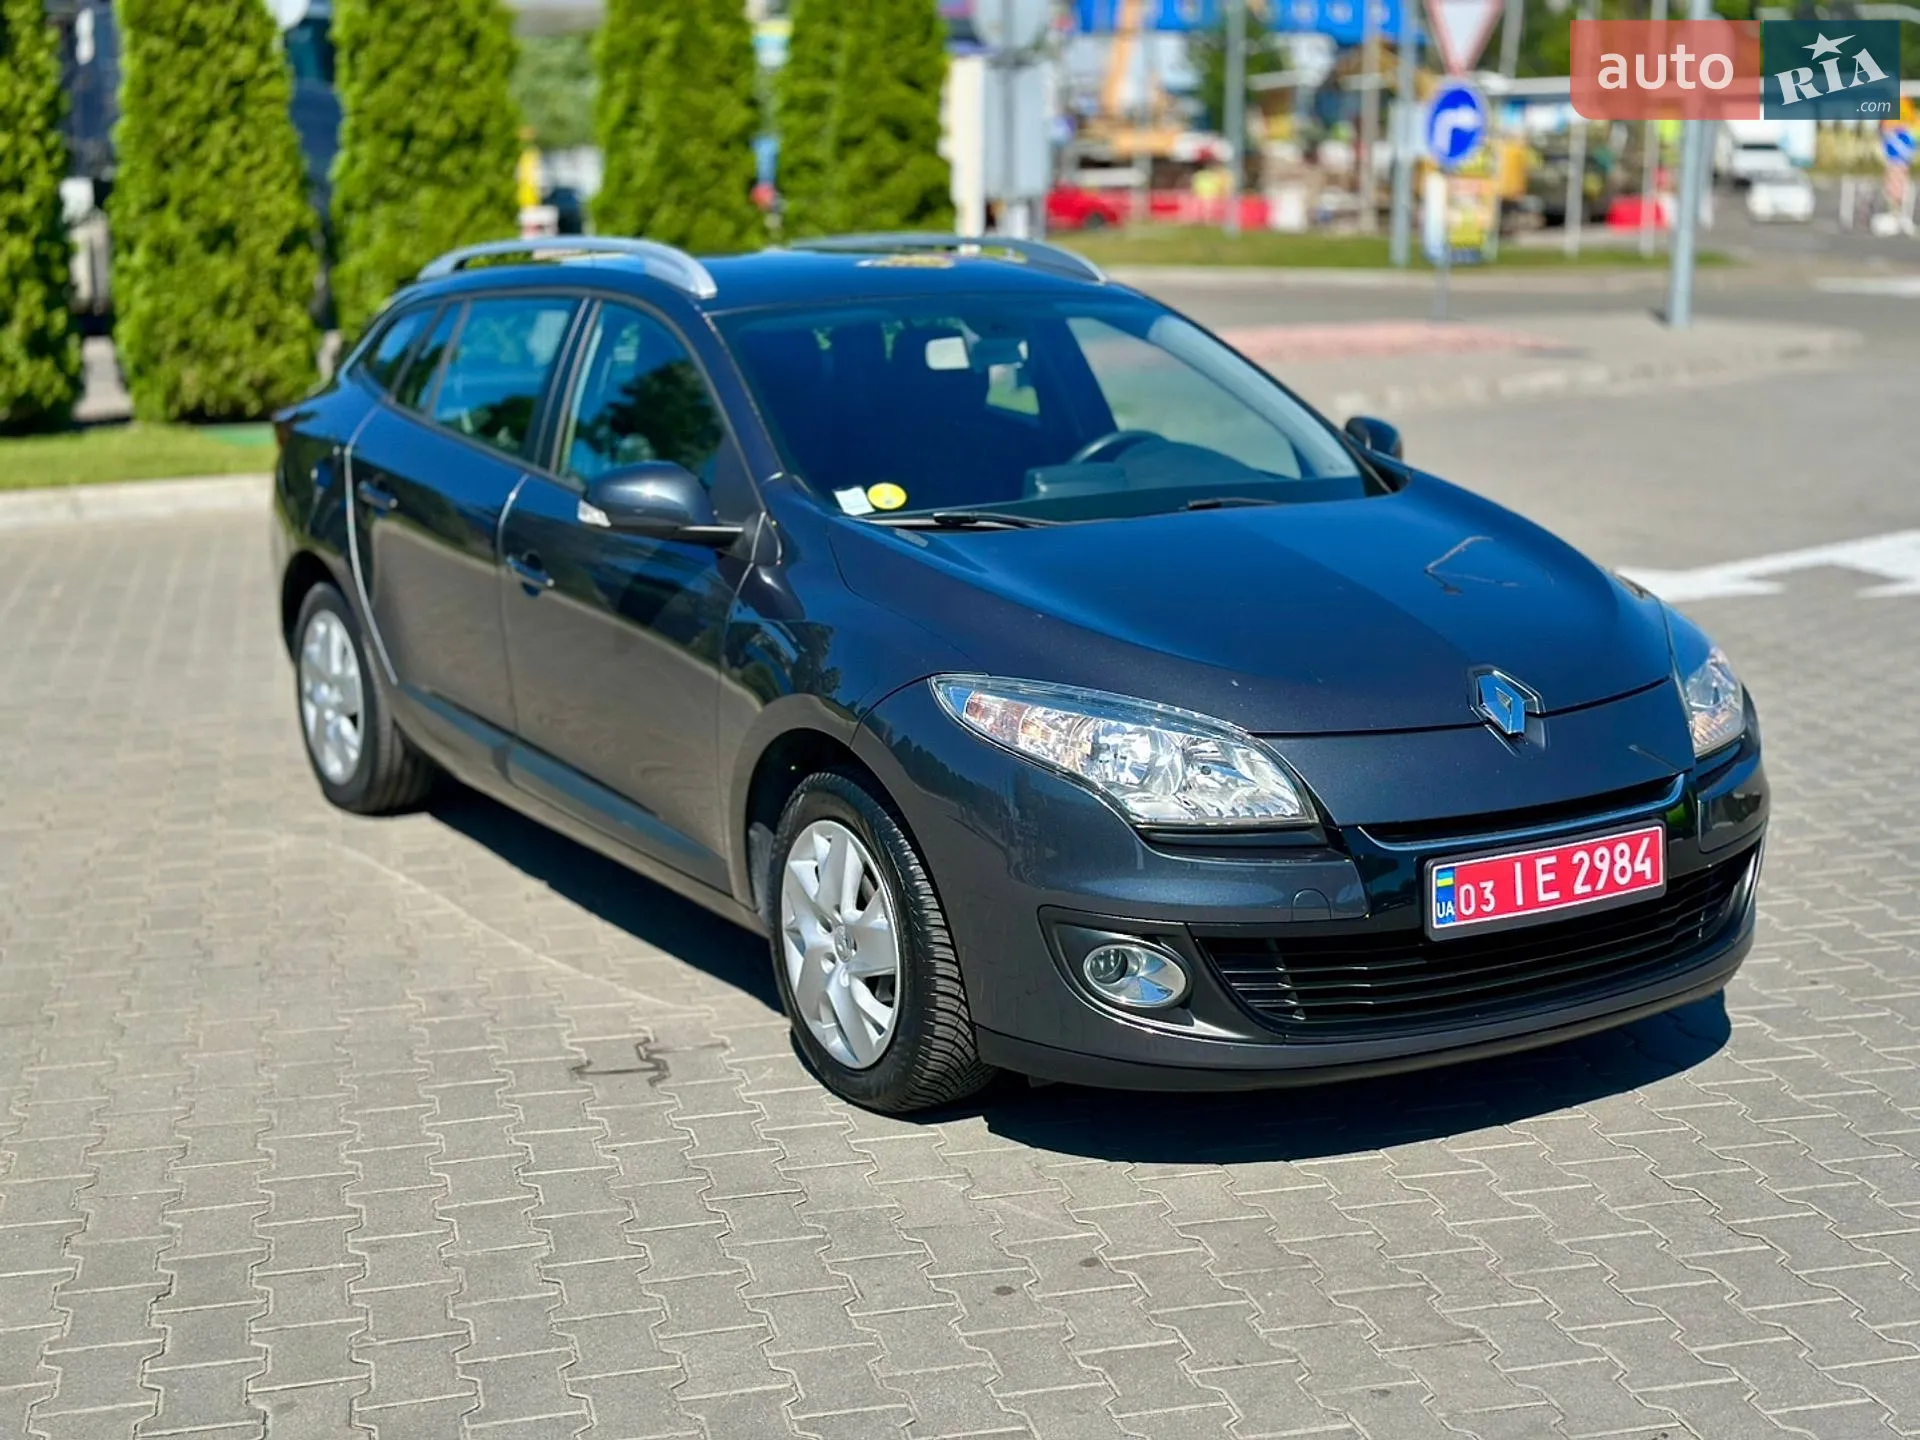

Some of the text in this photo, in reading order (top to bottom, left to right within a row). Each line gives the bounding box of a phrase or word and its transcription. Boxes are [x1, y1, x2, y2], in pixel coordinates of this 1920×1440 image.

[1459, 837, 1652, 916] 03 IE 2984
[1437, 902, 1455, 918] UA
